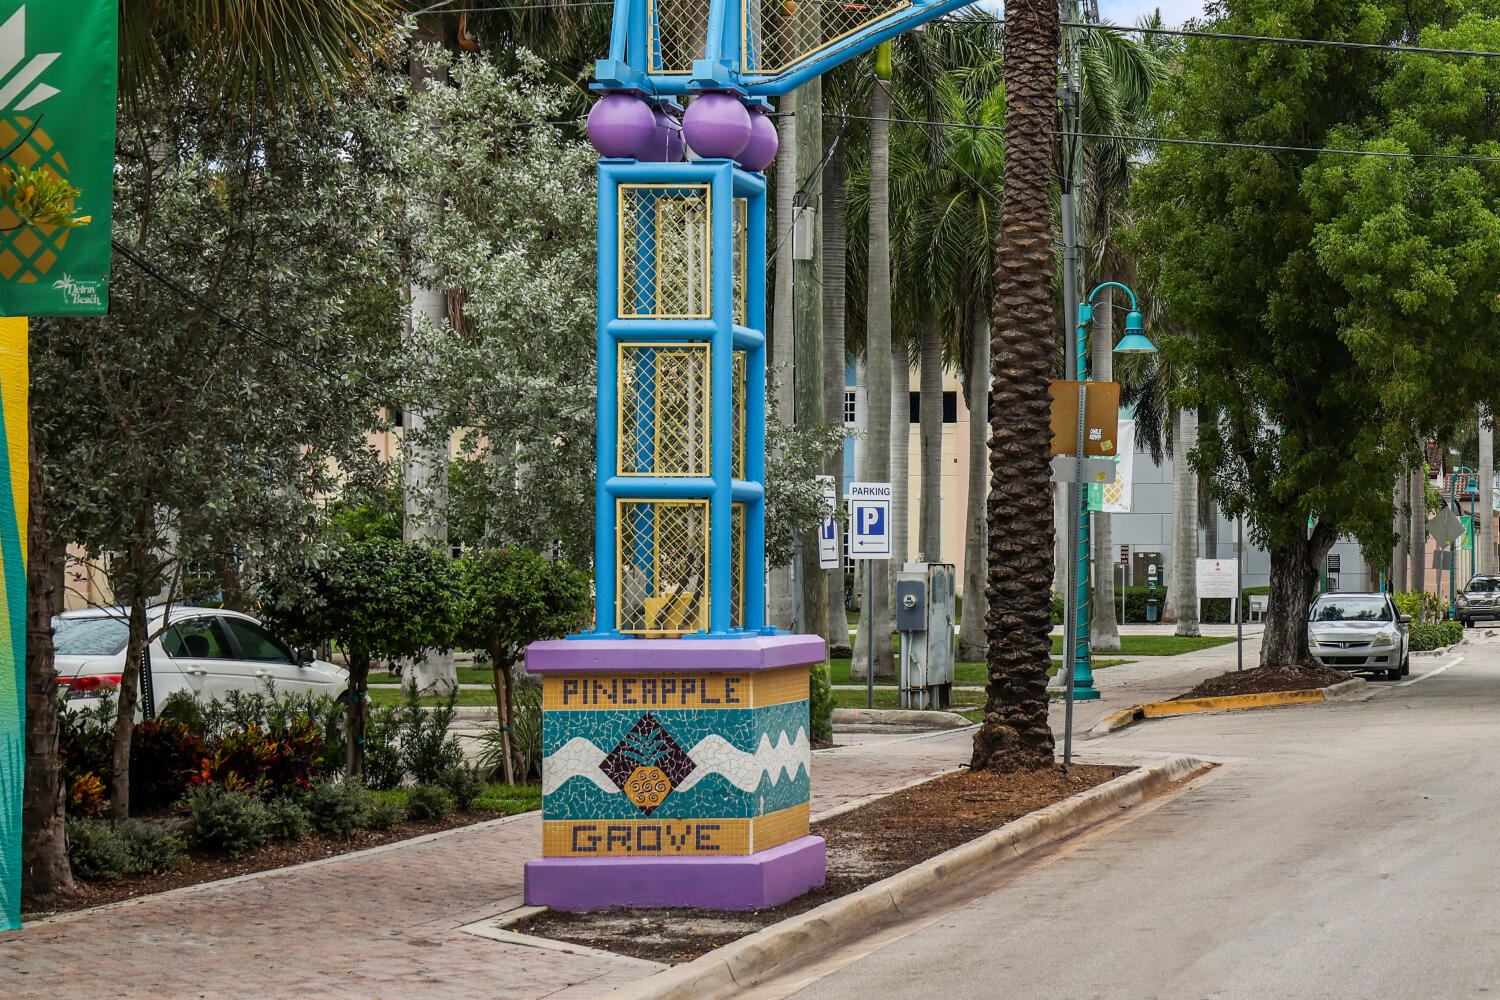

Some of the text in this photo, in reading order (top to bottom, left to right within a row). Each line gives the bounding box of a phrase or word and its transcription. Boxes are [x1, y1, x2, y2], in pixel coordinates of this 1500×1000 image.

[852, 487, 891, 496] PARKING
[863, 508, 879, 535] P
[563, 678, 741, 705] PINEAPPLE
[572, 824, 720, 852] GROVE
